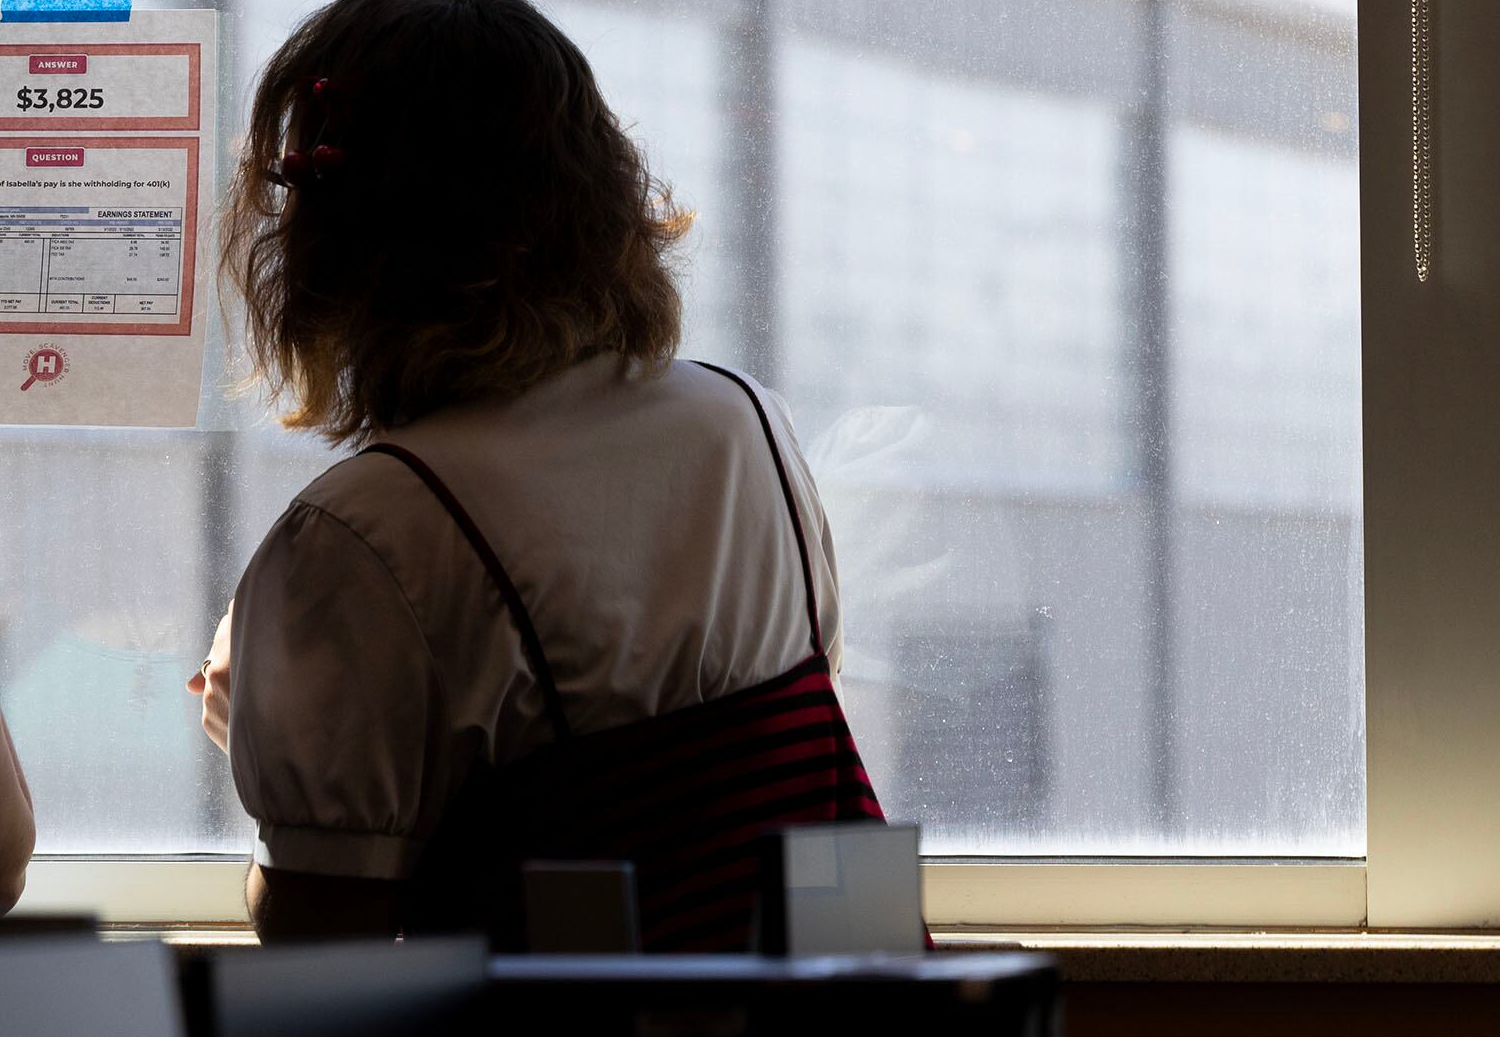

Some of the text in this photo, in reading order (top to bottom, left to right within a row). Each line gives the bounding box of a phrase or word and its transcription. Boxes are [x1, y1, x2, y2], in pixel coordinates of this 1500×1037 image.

[38, 61, 78, 69] ANSWER
[17, 86, 104, 112] $3,825
[32, 154, 79, 162] QUESTION
[43, 181, 58, 189] pay
[83, 180, 132, 189] withholding
[146, 180, 171, 189] 401(k)
[36, 355, 57, 373] H
[38, 343, 70, 373] SCAVENGER
[44, 374, 65, 388] HUNT
